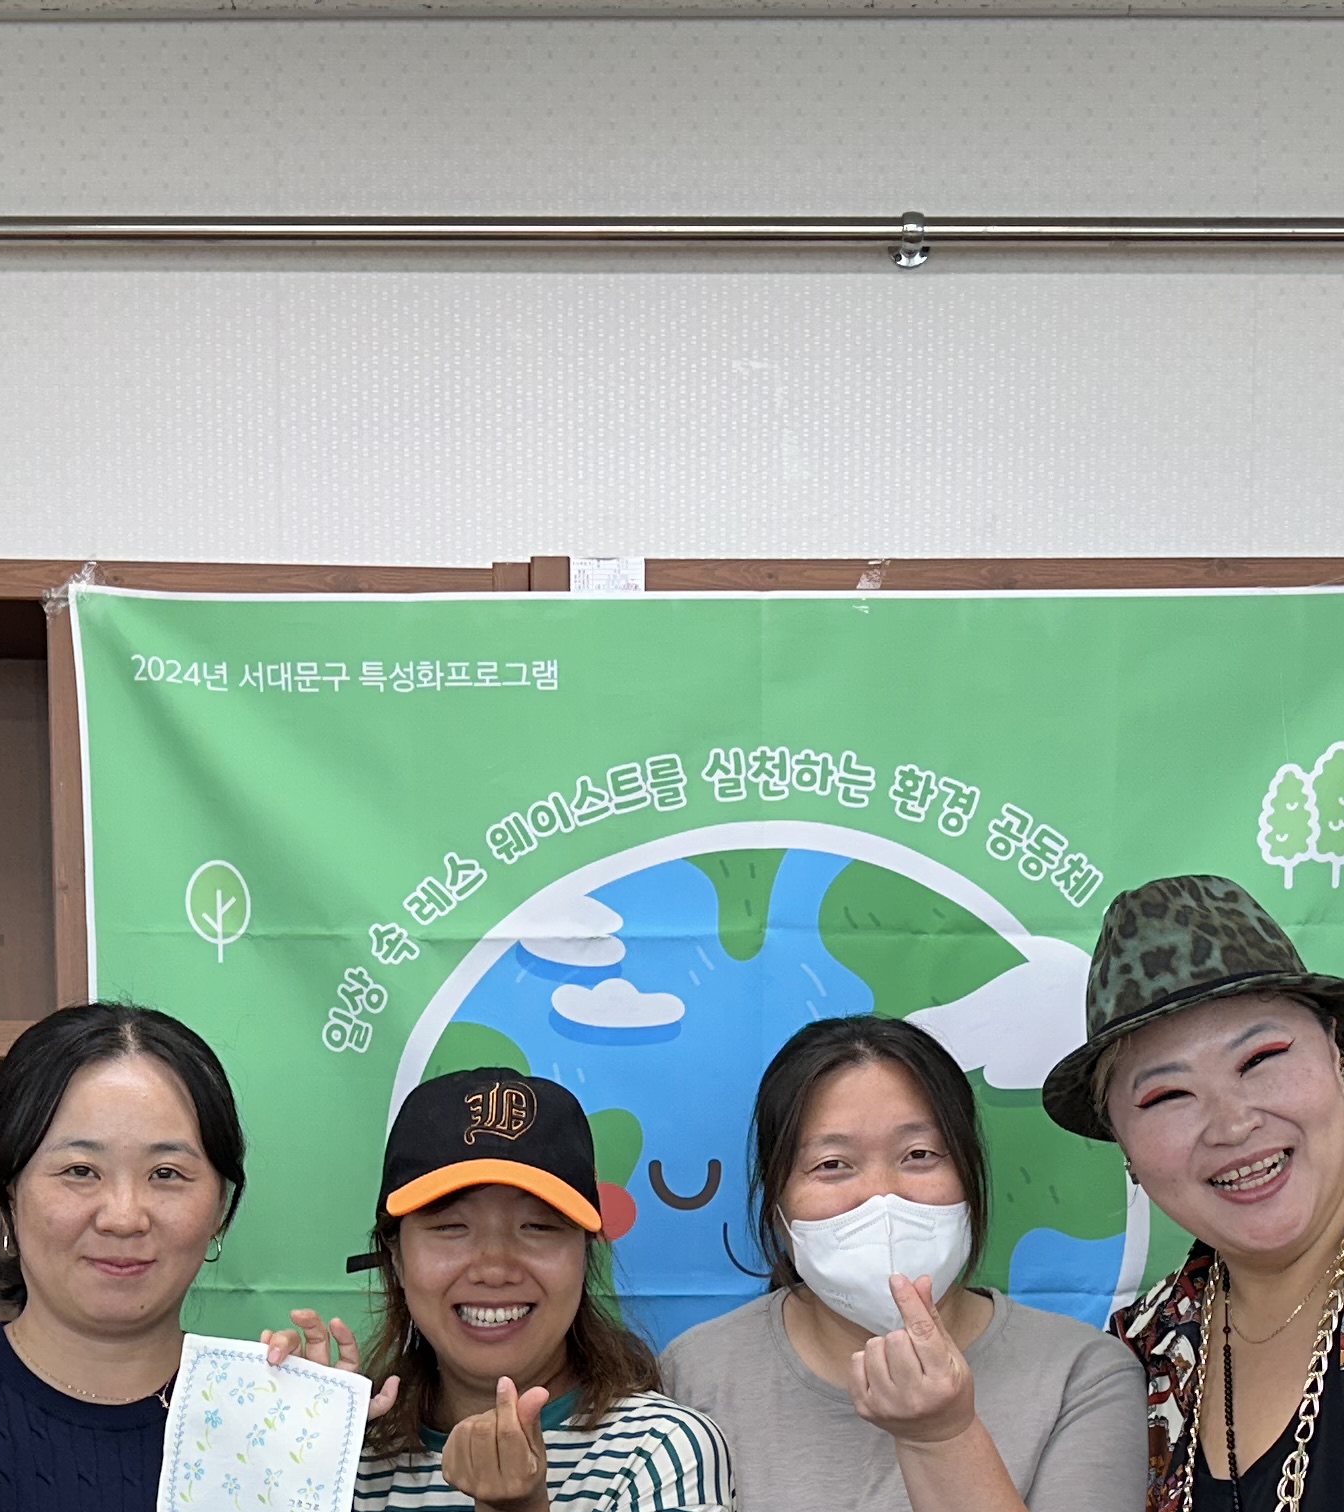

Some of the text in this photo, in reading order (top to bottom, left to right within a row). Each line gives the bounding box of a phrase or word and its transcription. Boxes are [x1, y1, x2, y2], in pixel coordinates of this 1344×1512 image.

[131, 654, 558, 692] 2024년 서대문구 특성화프로그램
[322, 747, 1104, 1053] 일상 속 레스 웨이스트를 실천하는 환경 공동체
